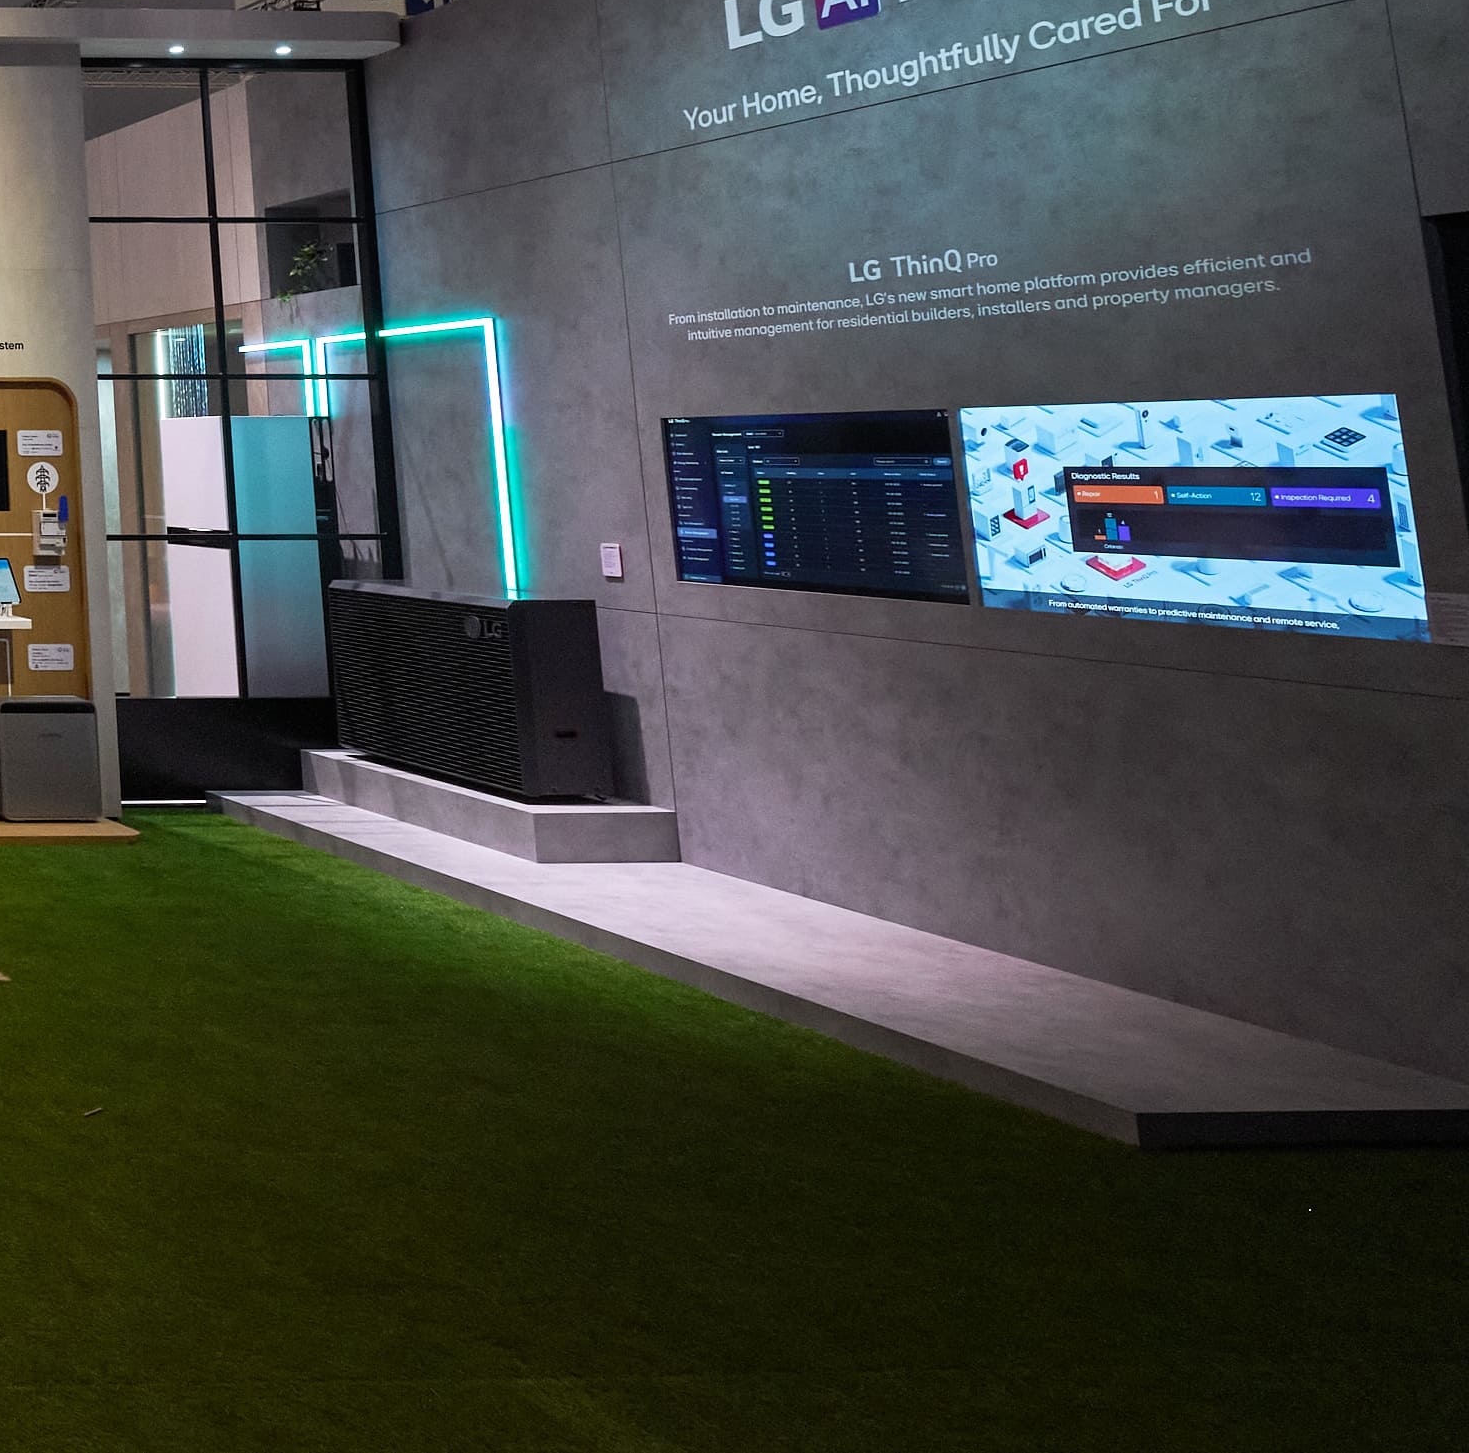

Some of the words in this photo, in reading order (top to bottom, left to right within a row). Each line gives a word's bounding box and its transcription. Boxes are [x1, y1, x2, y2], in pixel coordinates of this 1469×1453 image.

[683, 101, 737, 131] Your
[741, 83, 823, 117] Home,
[826, 31, 1021, 97] Thoughtfully
[1028, 0, 1143, 50] Cared
[848, 259, 882, 283] LG
[889, 248, 962, 278] ThinQ
[966, 252, 999, 269] Pro
[668, 312, 695, 325] From
[697, 305, 760, 323] installation
[762, 305, 775, 316] to
[777, 297, 864, 316] maintenance,
[865, 293, 896, 307] LG's
[898, 289, 927, 301] new
[930, 284, 974, 300] smart
[977, 280, 1021, 296] home
[1024, 271, 1097, 294] platform
[1100, 263, 1179, 286] provides
[1183, 252, 1267, 276] efficient
[1270, 247, 1311, 267] and
[687, 326, 732, 341] intuitive
[734, 320, 814, 338] management
[816, 317, 835, 330] for
[837, 311, 909, 328] residential
[911, 305, 975, 323] builders,
[977, 298, 1051, 318] installers
[1054, 293, 1088, 310] and
[1092, 287, 1170, 310] property
[1174, 277, 1281, 301] managers.
[1071, 472, 1111, 481] Diagnostic
[1111, 472, 1140, 480] Results
[1154, 491, 1159, 499] 1
[1250, 492, 1261, 501] 12
[1280, 494, 1318, 502] Inspection
[1318, 494, 1351, 503] Required
[1367, 494, 1376, 503] 4
[1049, 599, 1067, 608] From
[1067, 600, 1108, 611] automated
[1108, 603, 1148, 614] warranties
[1148, 607, 1157, 615] to
[1157, 607, 1197, 619] predictive
[1198, 611, 1253, 622] maintenance
[1253, 614, 1271, 624] and
[1271, 616, 1304, 627] remote
[1304, 619, 1340, 630] service,
[483, 619, 502, 638] LG
